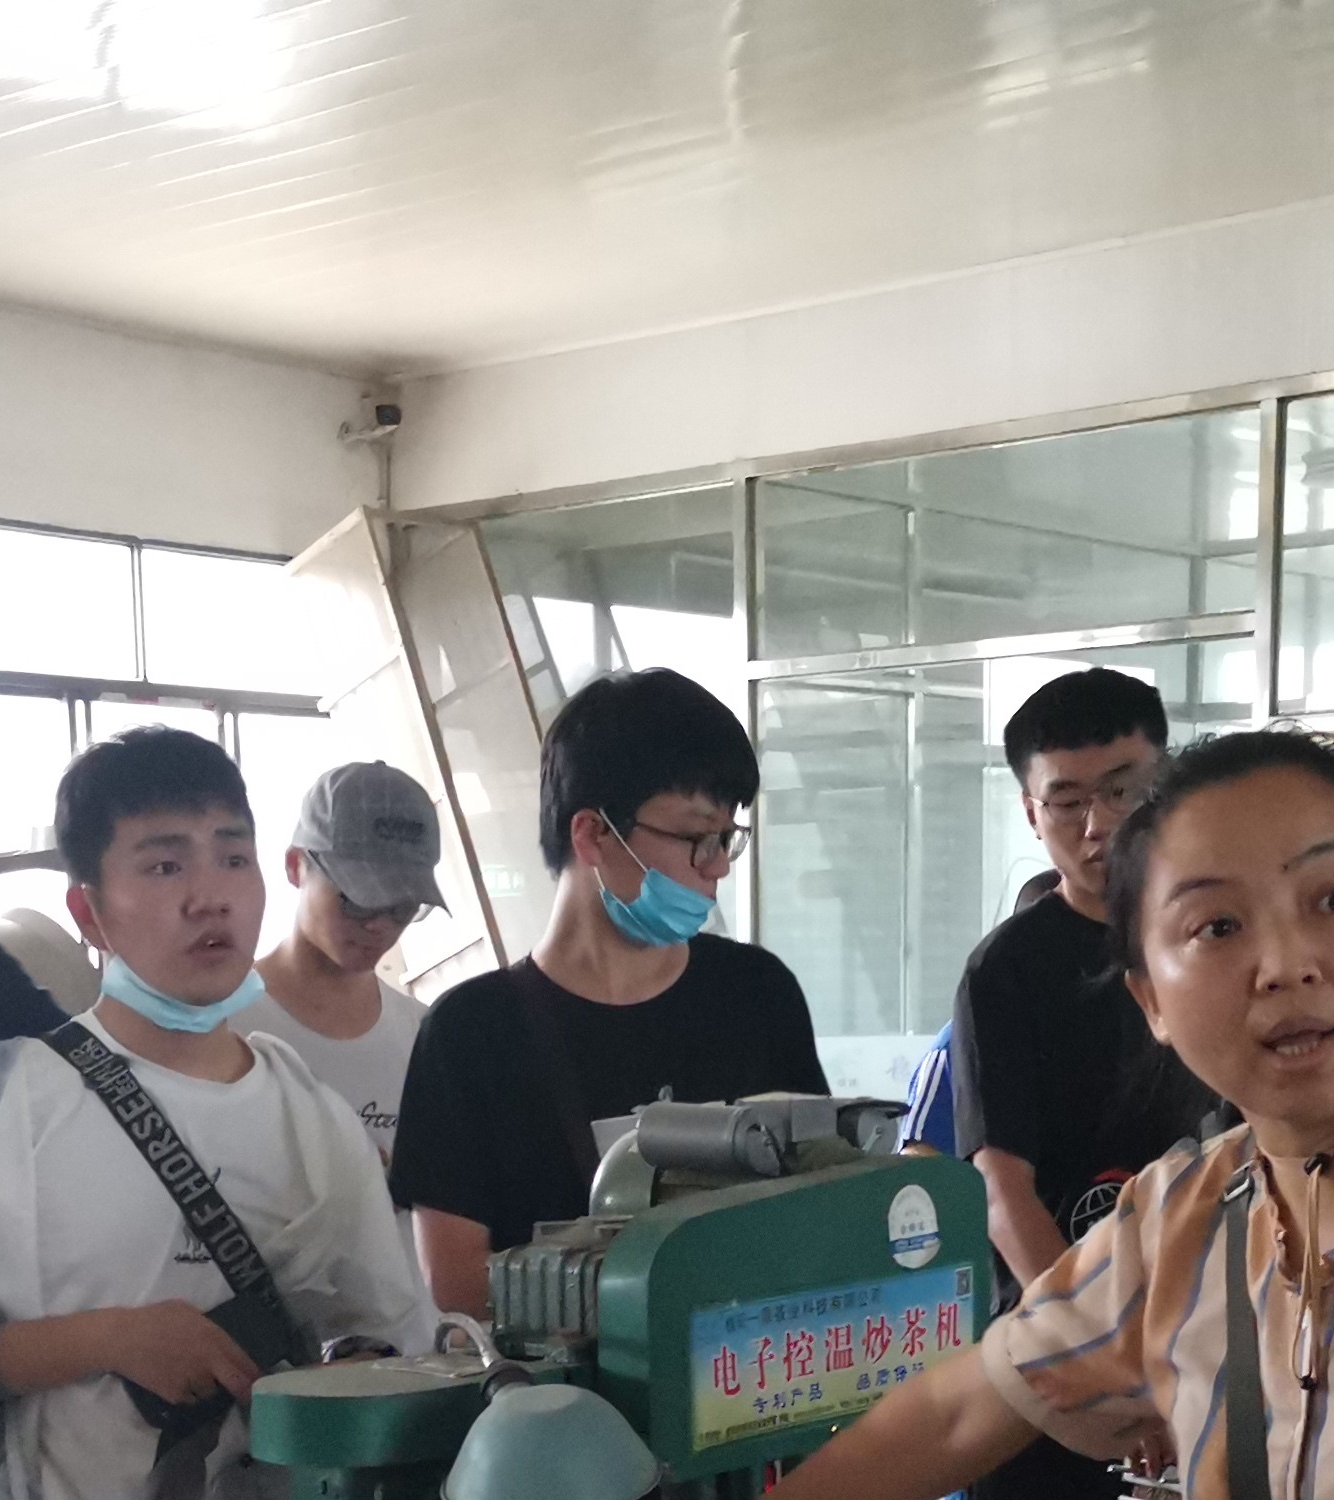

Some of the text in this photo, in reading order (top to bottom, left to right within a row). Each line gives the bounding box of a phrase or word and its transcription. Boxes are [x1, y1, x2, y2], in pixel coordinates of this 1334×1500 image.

[116, 1089, 213, 1205] HORSE
[713, 1302, 962, 1397] 电子控温炒茶机
[752, 1382, 824, 1414] 专利产品
